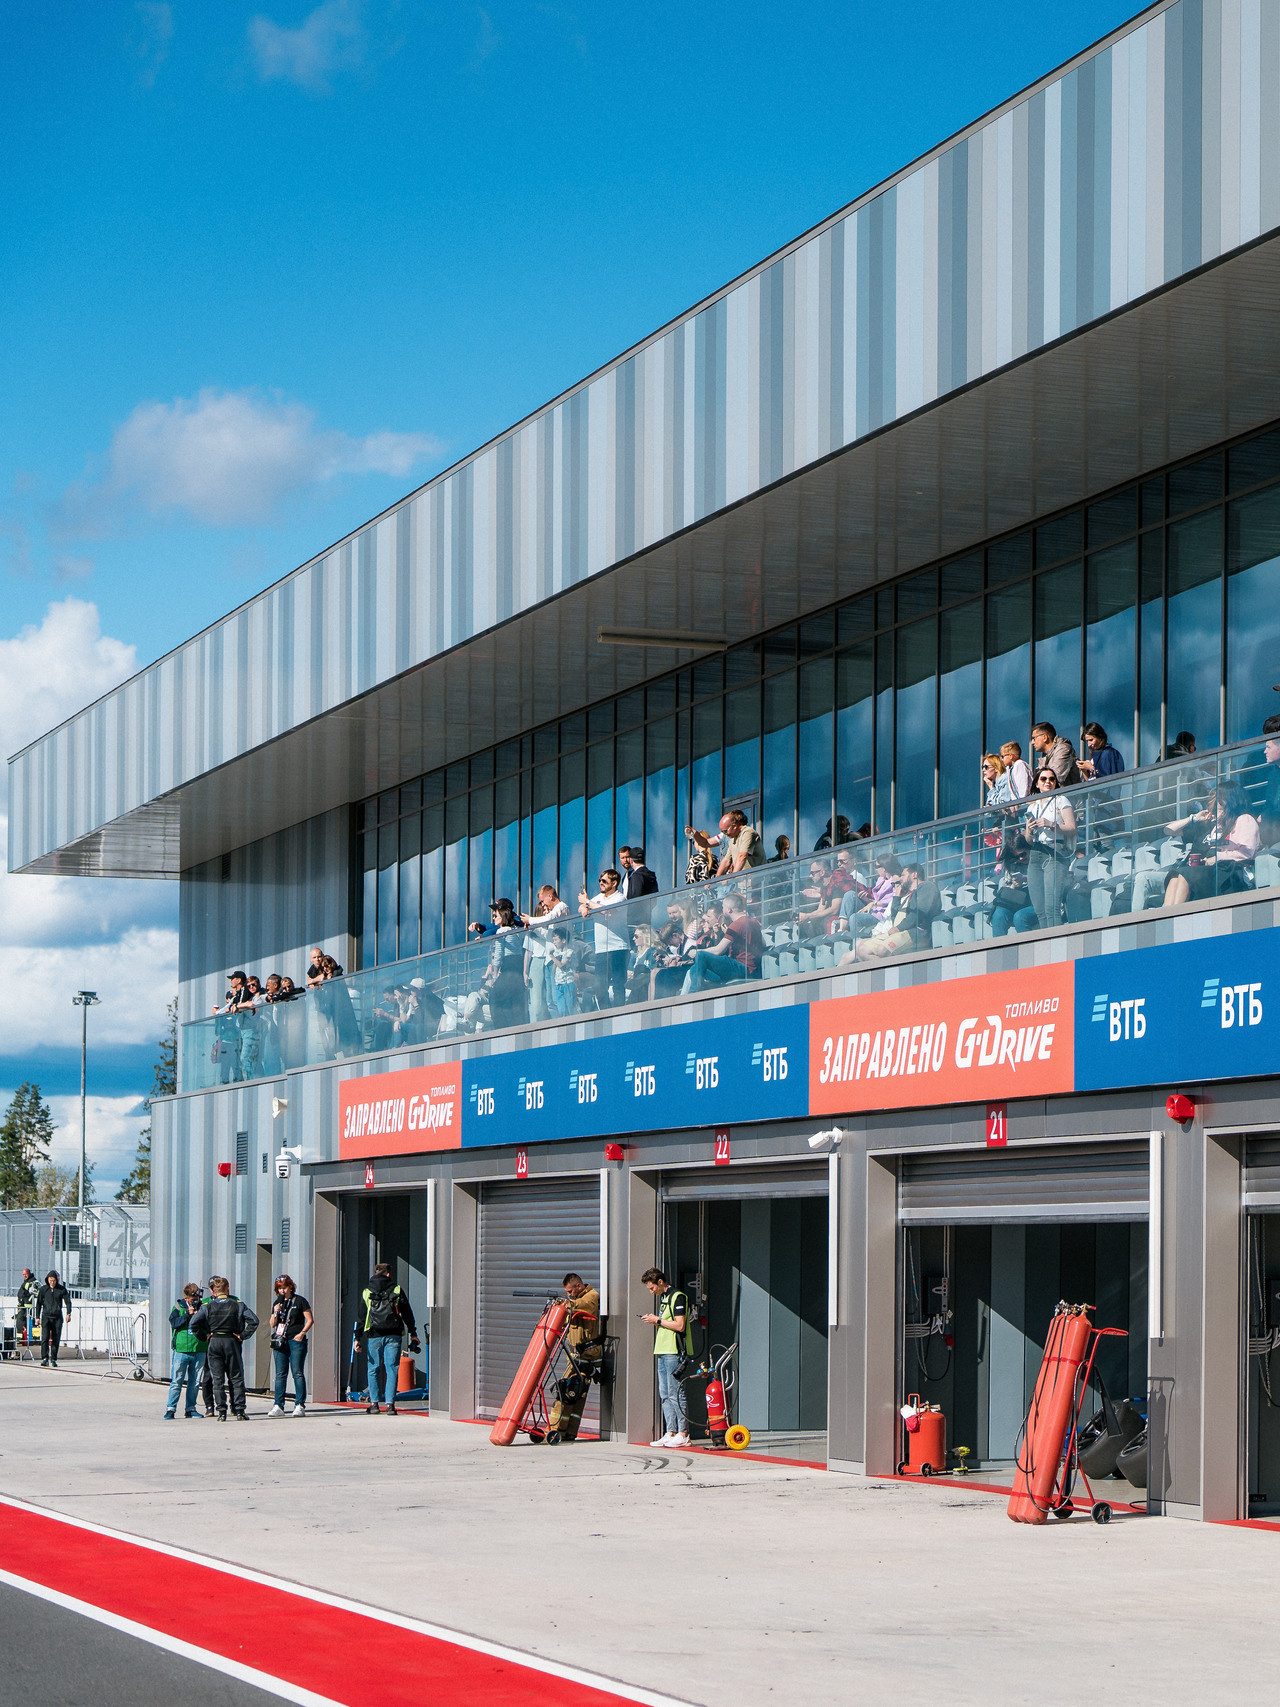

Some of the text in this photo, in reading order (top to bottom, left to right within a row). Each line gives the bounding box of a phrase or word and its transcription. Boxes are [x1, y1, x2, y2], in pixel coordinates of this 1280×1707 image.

[1005, 997, 1060, 1019] ТОПЛИВО
[1109, 998, 1146, 1042] ВТБ
[1220, 982, 1263, 1029] ВТБ
[763, 1046, 788, 1082] ВТБ
[819, 1021, 948, 1084] ЗАПРАВЛЕНО
[633, 1065, 656, 1097] ВТБ
[695, 1056, 719, 1090] ВТБ
[430, 1084, 456, 1098] ТОПЛИВО
[477, 1086, 495, 1116] ВТБ
[525, 1080, 544, 1110] ВТБ
[577, 1073, 598, 1104] ВТБ
[343, 1097, 406, 1139] ЗАПРАВЛЕНО
[989, 1110, 1003, 1140] 21
[716, 1134, 728, 1159] 22
[365, 1164, 373, 1184] 24
[517, 1151, 527, 1173] 23
[107, 1232, 150, 1258] 4K
